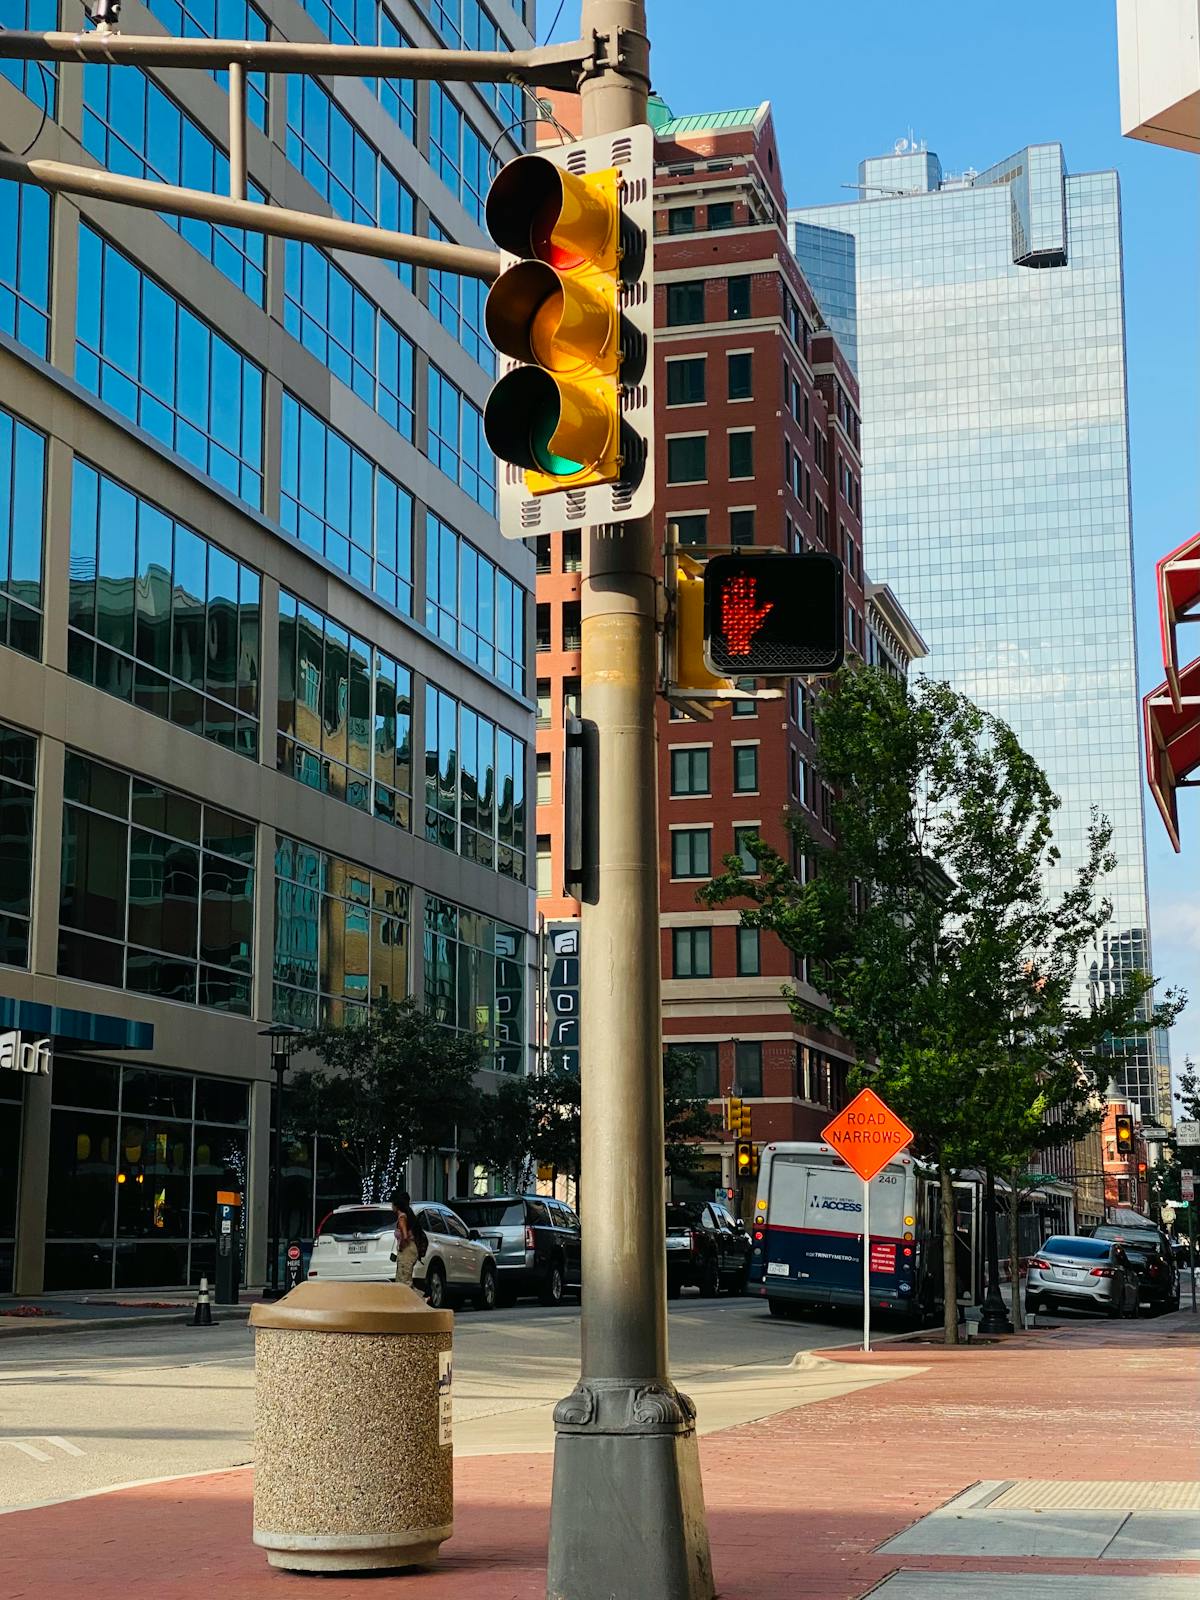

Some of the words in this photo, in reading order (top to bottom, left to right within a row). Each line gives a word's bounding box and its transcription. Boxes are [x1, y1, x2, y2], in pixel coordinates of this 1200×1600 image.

[847, 1112, 886, 1125] ROAD
[833, 1130, 901, 1144] NARROWS
[878, 1175, 897, 1185] 240
[222, 1205, 230, 1217] P
[821, 1200, 863, 1213] ACCESS
